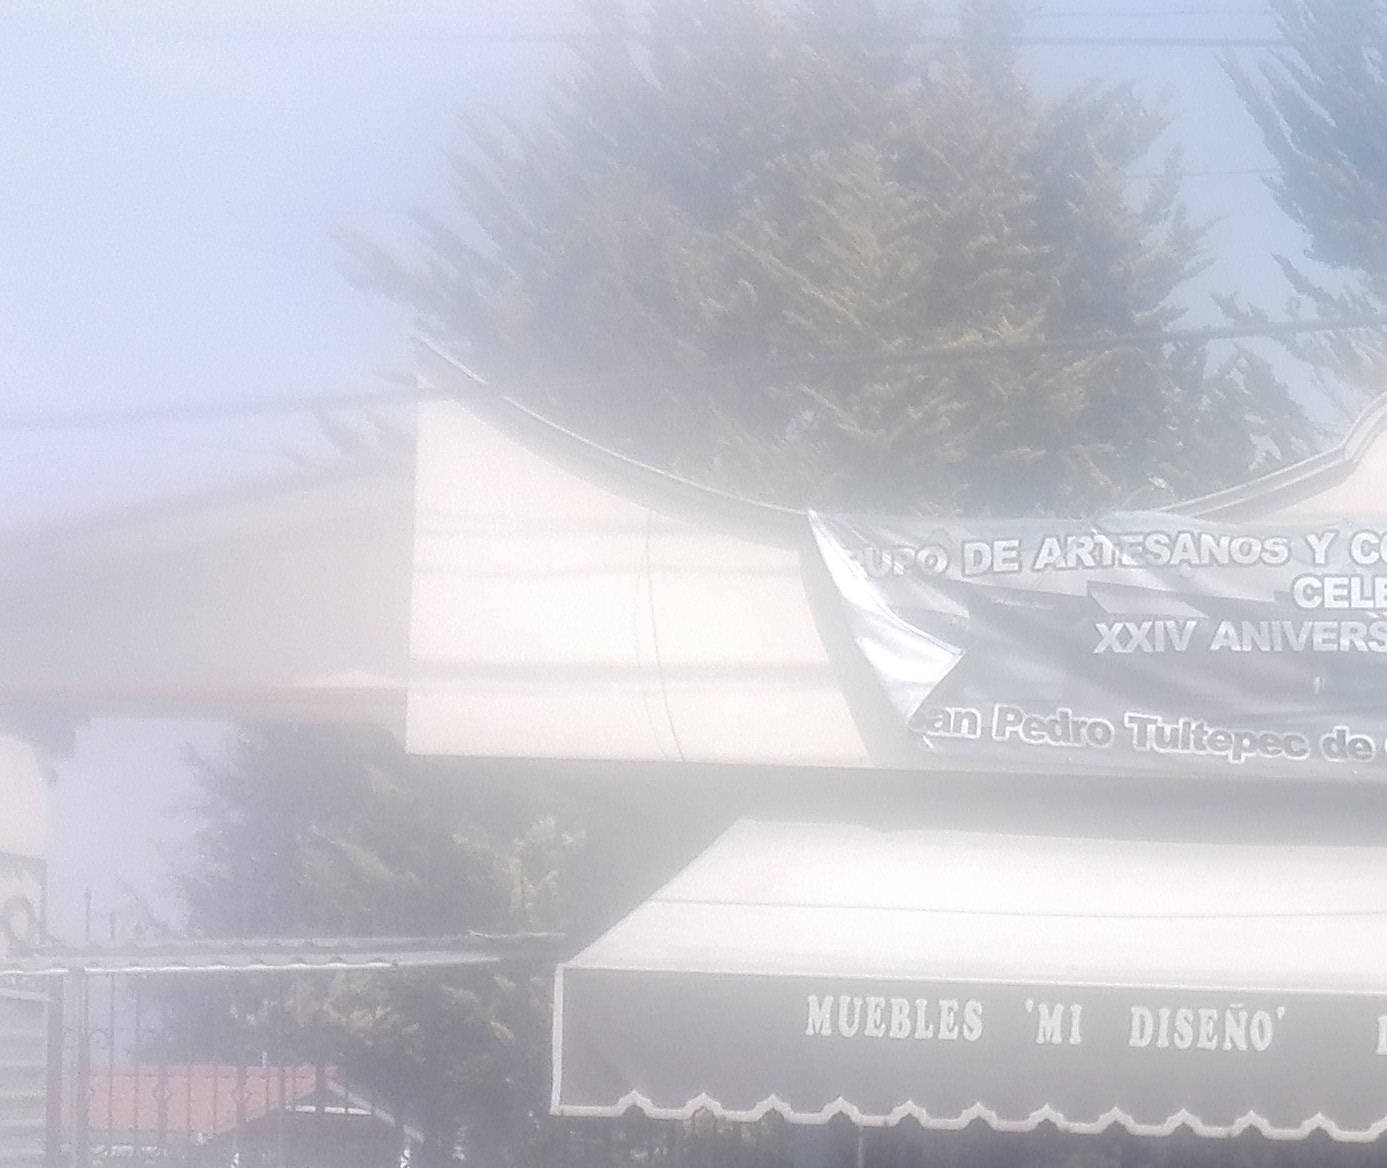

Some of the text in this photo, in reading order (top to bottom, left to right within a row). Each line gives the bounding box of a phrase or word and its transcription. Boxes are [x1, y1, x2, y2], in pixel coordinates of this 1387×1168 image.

[844, 544, 949, 579] UPO
[961, 539, 1021, 578] DE
[1033, 531, 1290, 570] ARTESANOS
[1305, 531, 1339, 566] Y
[1093, 619, 1198, 654] XXIV
[912, 705, 981, 740] an
[991, 703, 1115, 747] Pedro
[1123, 711, 1311, 763] Tultepec
[1321, 725, 1376, 762] de
[804, 994, 985, 1042] MUEBLES
